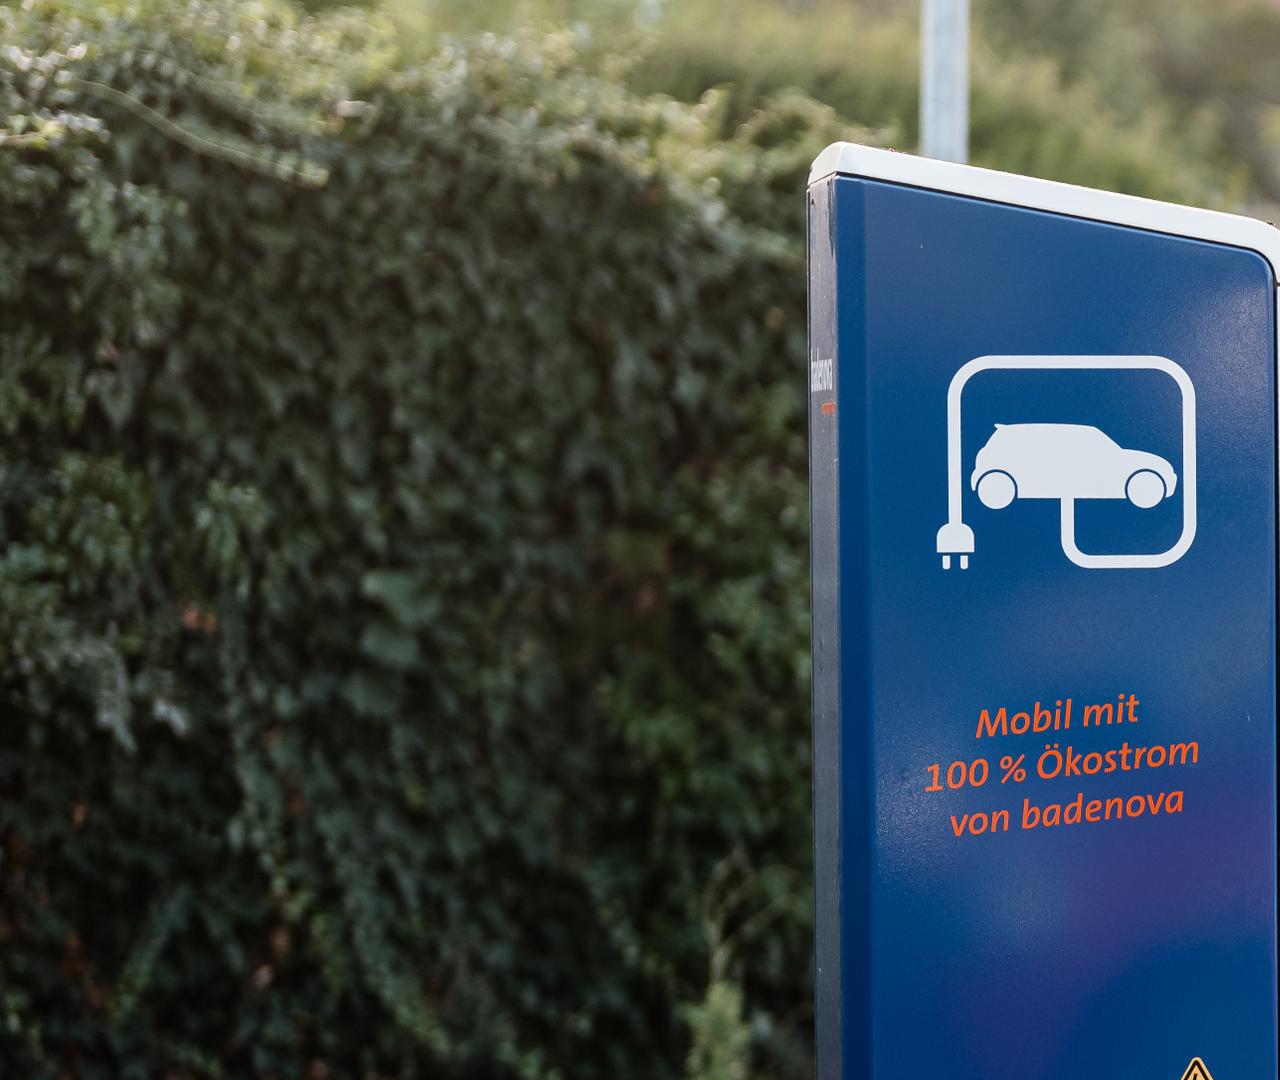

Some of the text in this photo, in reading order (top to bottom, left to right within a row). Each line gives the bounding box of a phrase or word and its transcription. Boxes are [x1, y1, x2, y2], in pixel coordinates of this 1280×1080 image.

[975, 693, 1140, 740] Mobil mit
[923, 740, 1199, 793] 100 % Ökostrom
[950, 789, 1185, 838] von badenova
